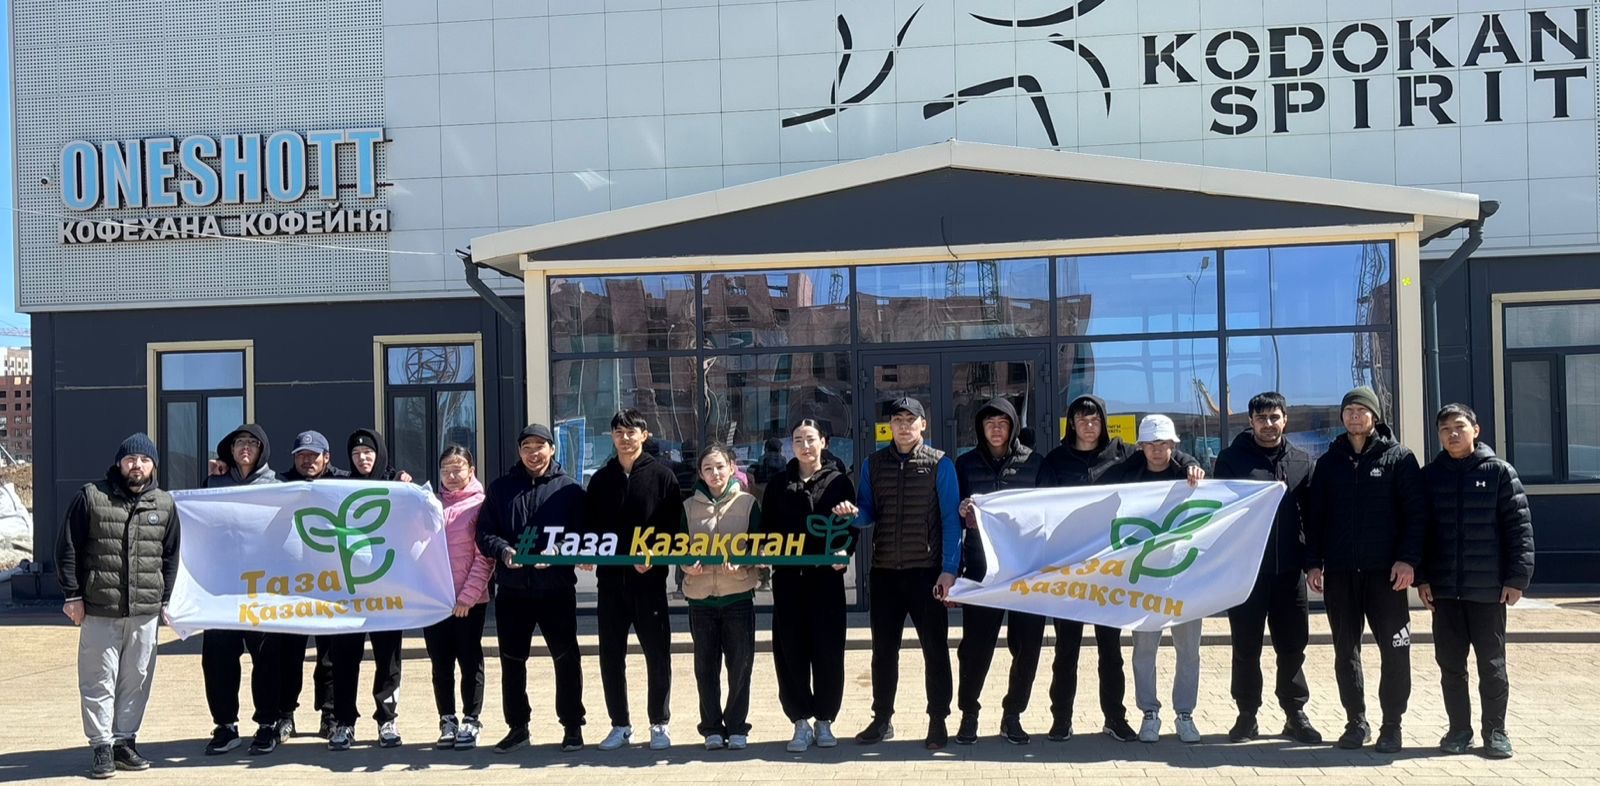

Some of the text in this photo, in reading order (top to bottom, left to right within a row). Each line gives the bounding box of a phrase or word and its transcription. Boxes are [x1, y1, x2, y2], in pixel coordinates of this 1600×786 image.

[1143, 8, 1590, 85] KODOKAN
[1209, 66, 1588, 136] SPIRIT
[61, 127, 386, 211] ONESHOTT
[60, 203, 390, 244] КОФЕХАНА КОФЕЙНЯ
[629, 526, 806, 567] Қазақстан
[240, 569, 342, 598] Таза
[239, 594, 404, 626] Қазақстан
